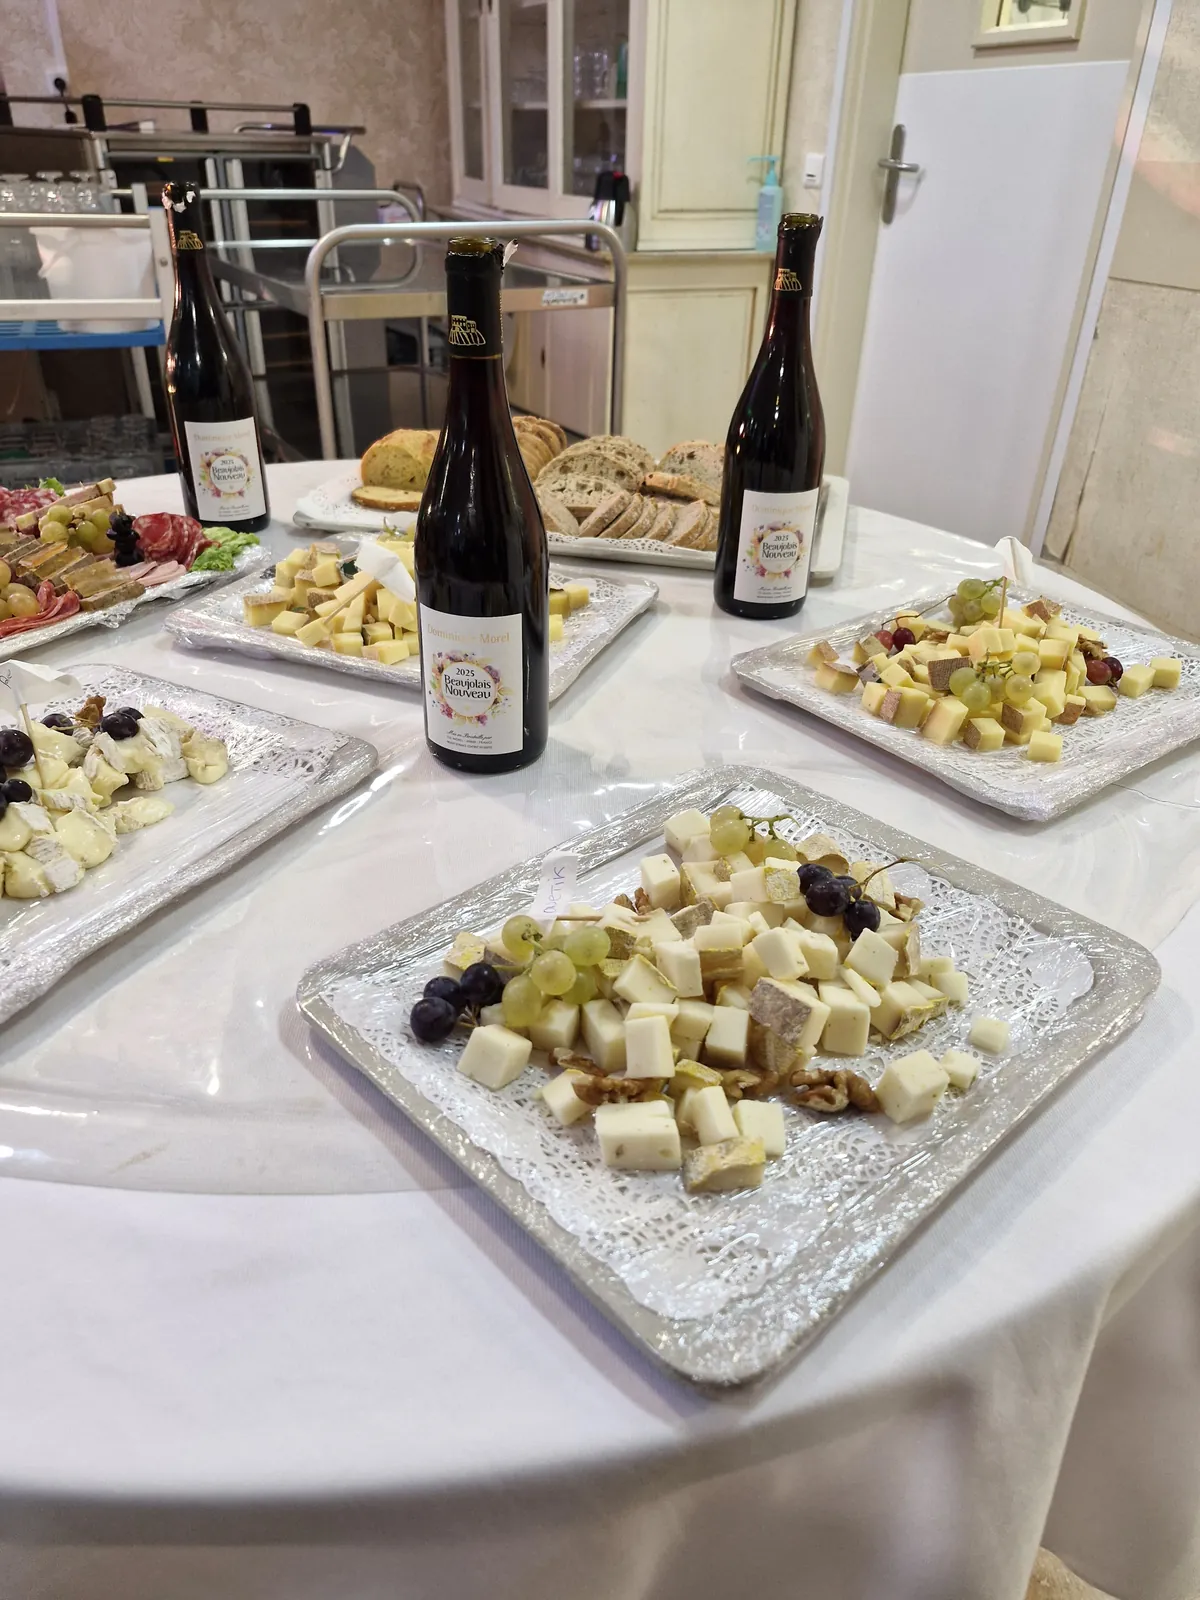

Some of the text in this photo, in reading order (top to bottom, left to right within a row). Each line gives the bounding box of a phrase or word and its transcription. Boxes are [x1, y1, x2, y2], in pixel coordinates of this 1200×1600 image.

[212, 465, 244, 474] Beaujolais
[213, 472, 245, 481] Nouveau
[762, 541, 797, 551] Beaujolais
[762, 549, 796, 559] Nouveau
[480, 632, 510, 644] Morel
[456, 667, 475, 677] 2025
[444, 674, 491, 689] Beaujolais
[445, 684, 491, 699] Nouveau
